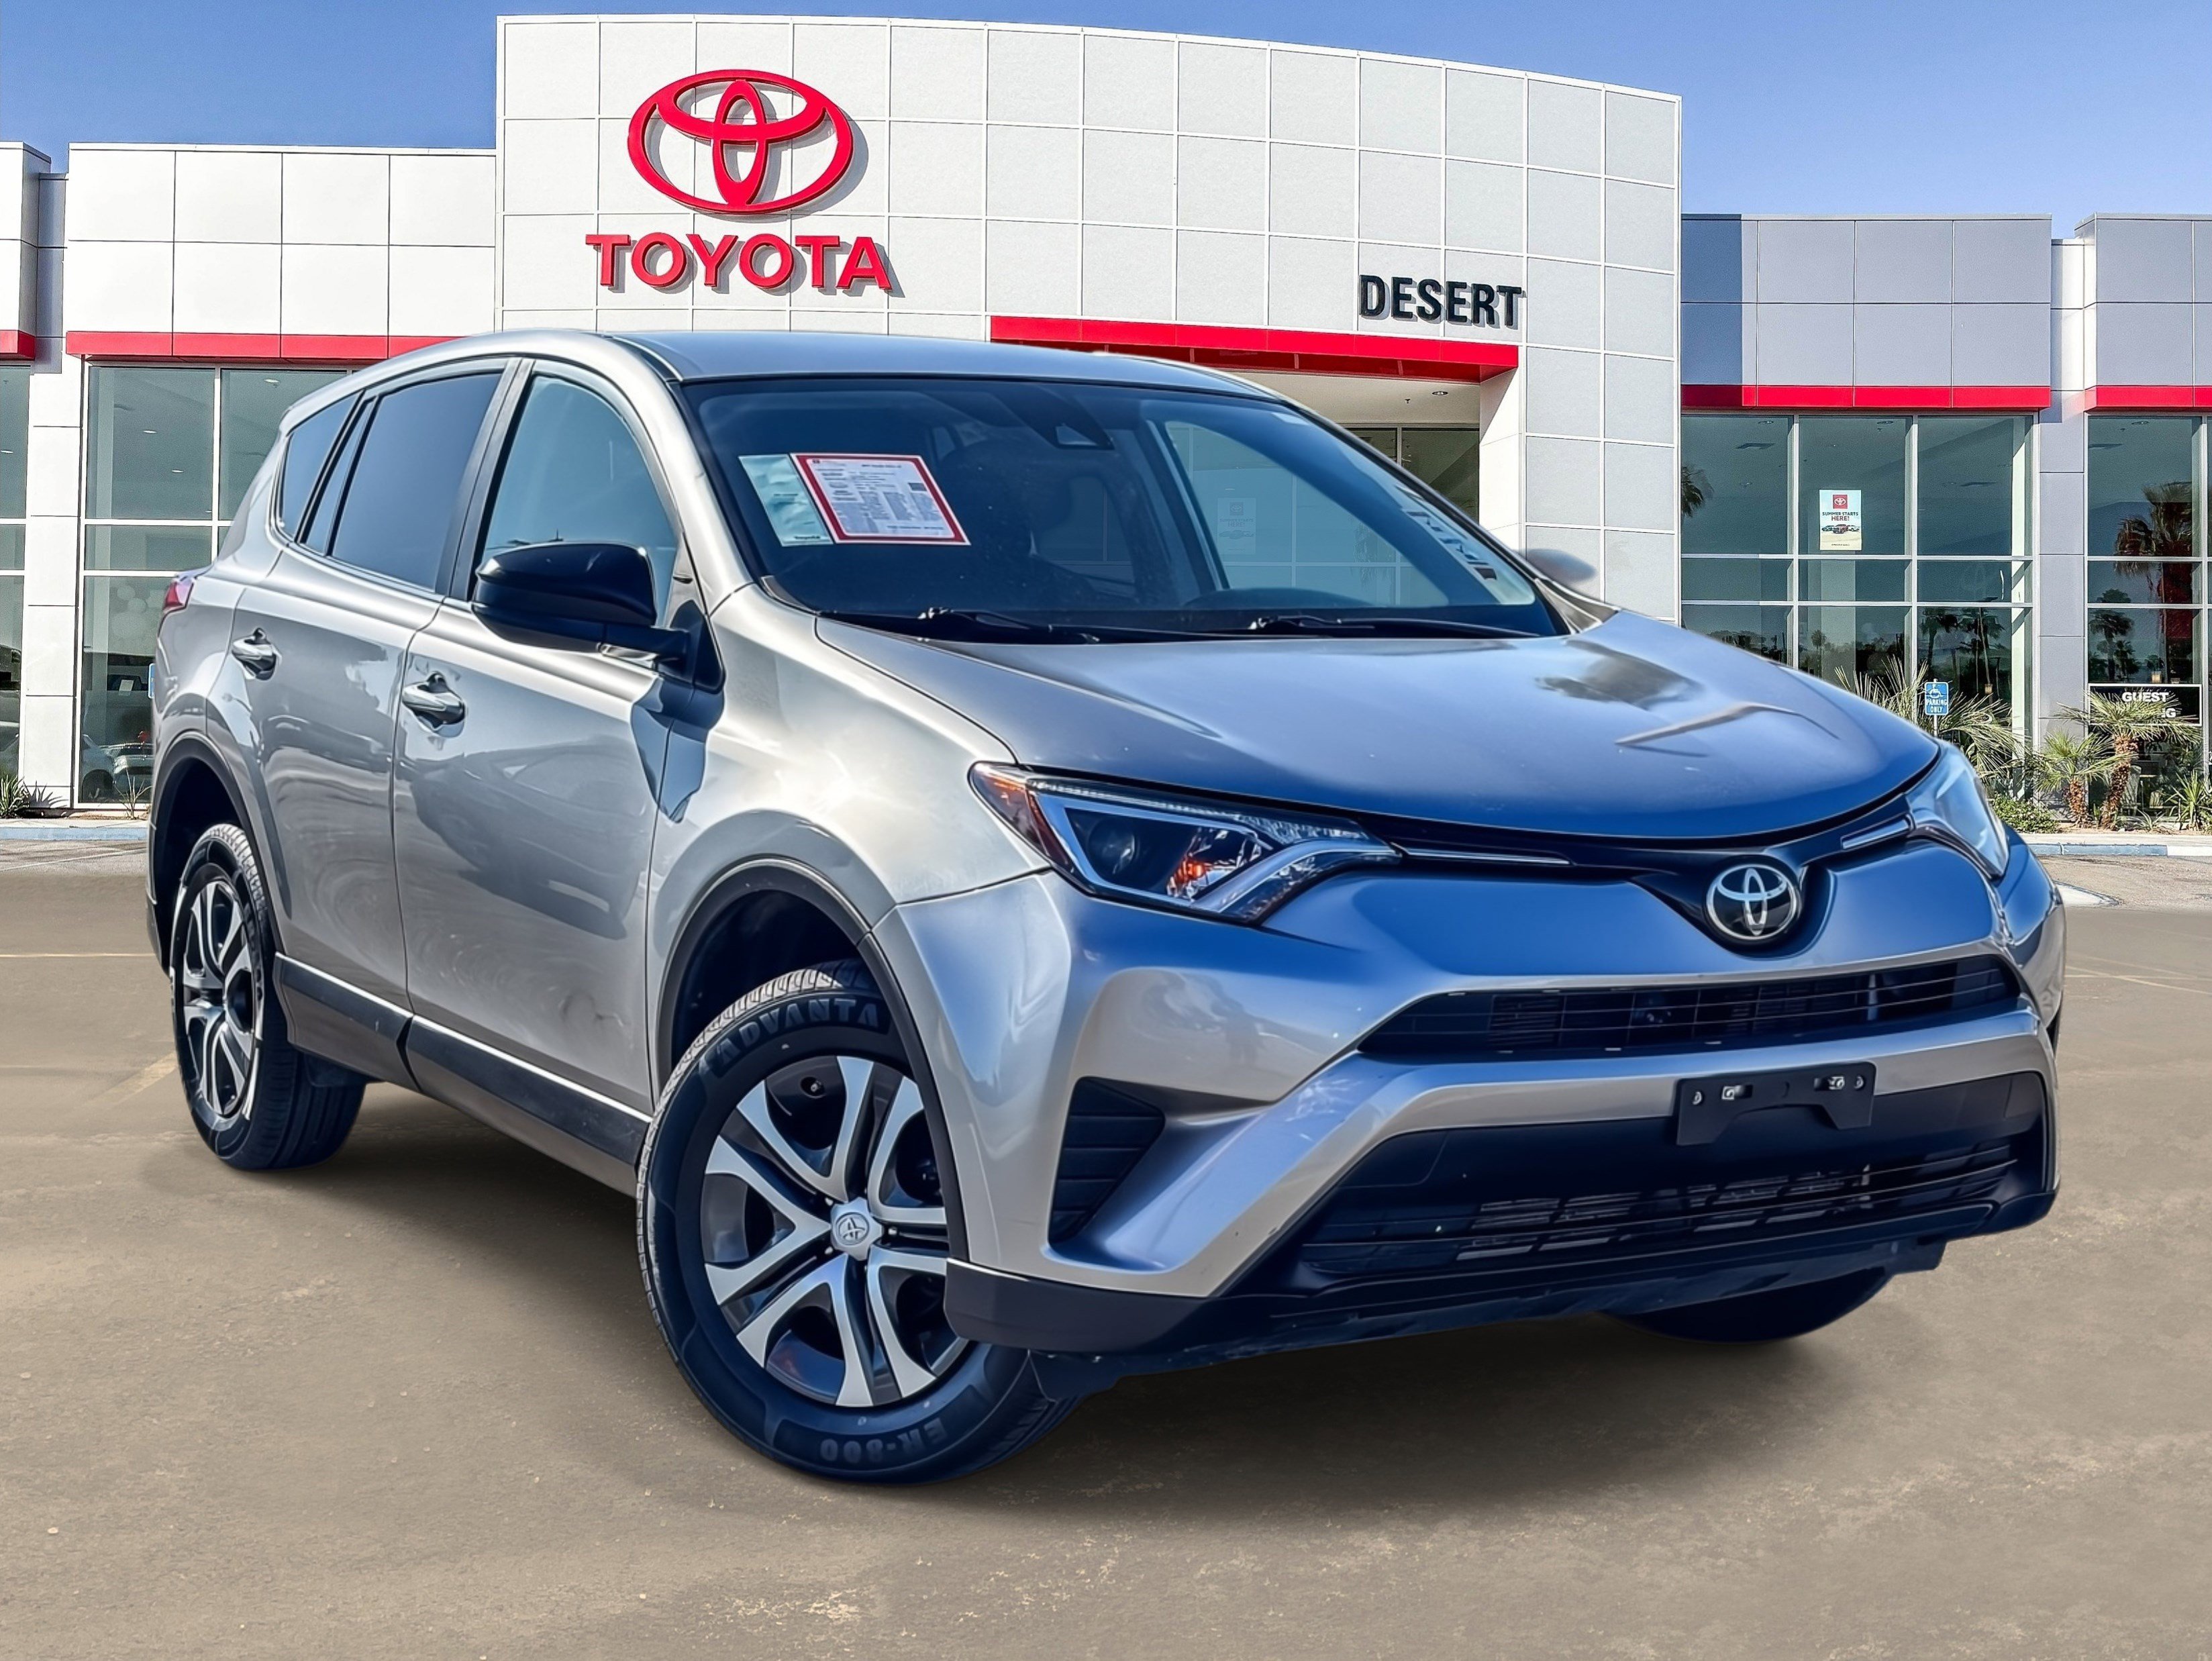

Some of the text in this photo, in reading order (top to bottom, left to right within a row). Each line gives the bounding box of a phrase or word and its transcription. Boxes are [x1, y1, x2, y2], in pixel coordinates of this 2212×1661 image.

[585, 232, 893, 290] TOYOTA
[1358, 274, 1523, 327] DESERT
[2121, 692, 2169, 703] GUEST
[715, 997, 879, 1063] ADVANTA
[819, 1417, 949, 1464] ER-800
